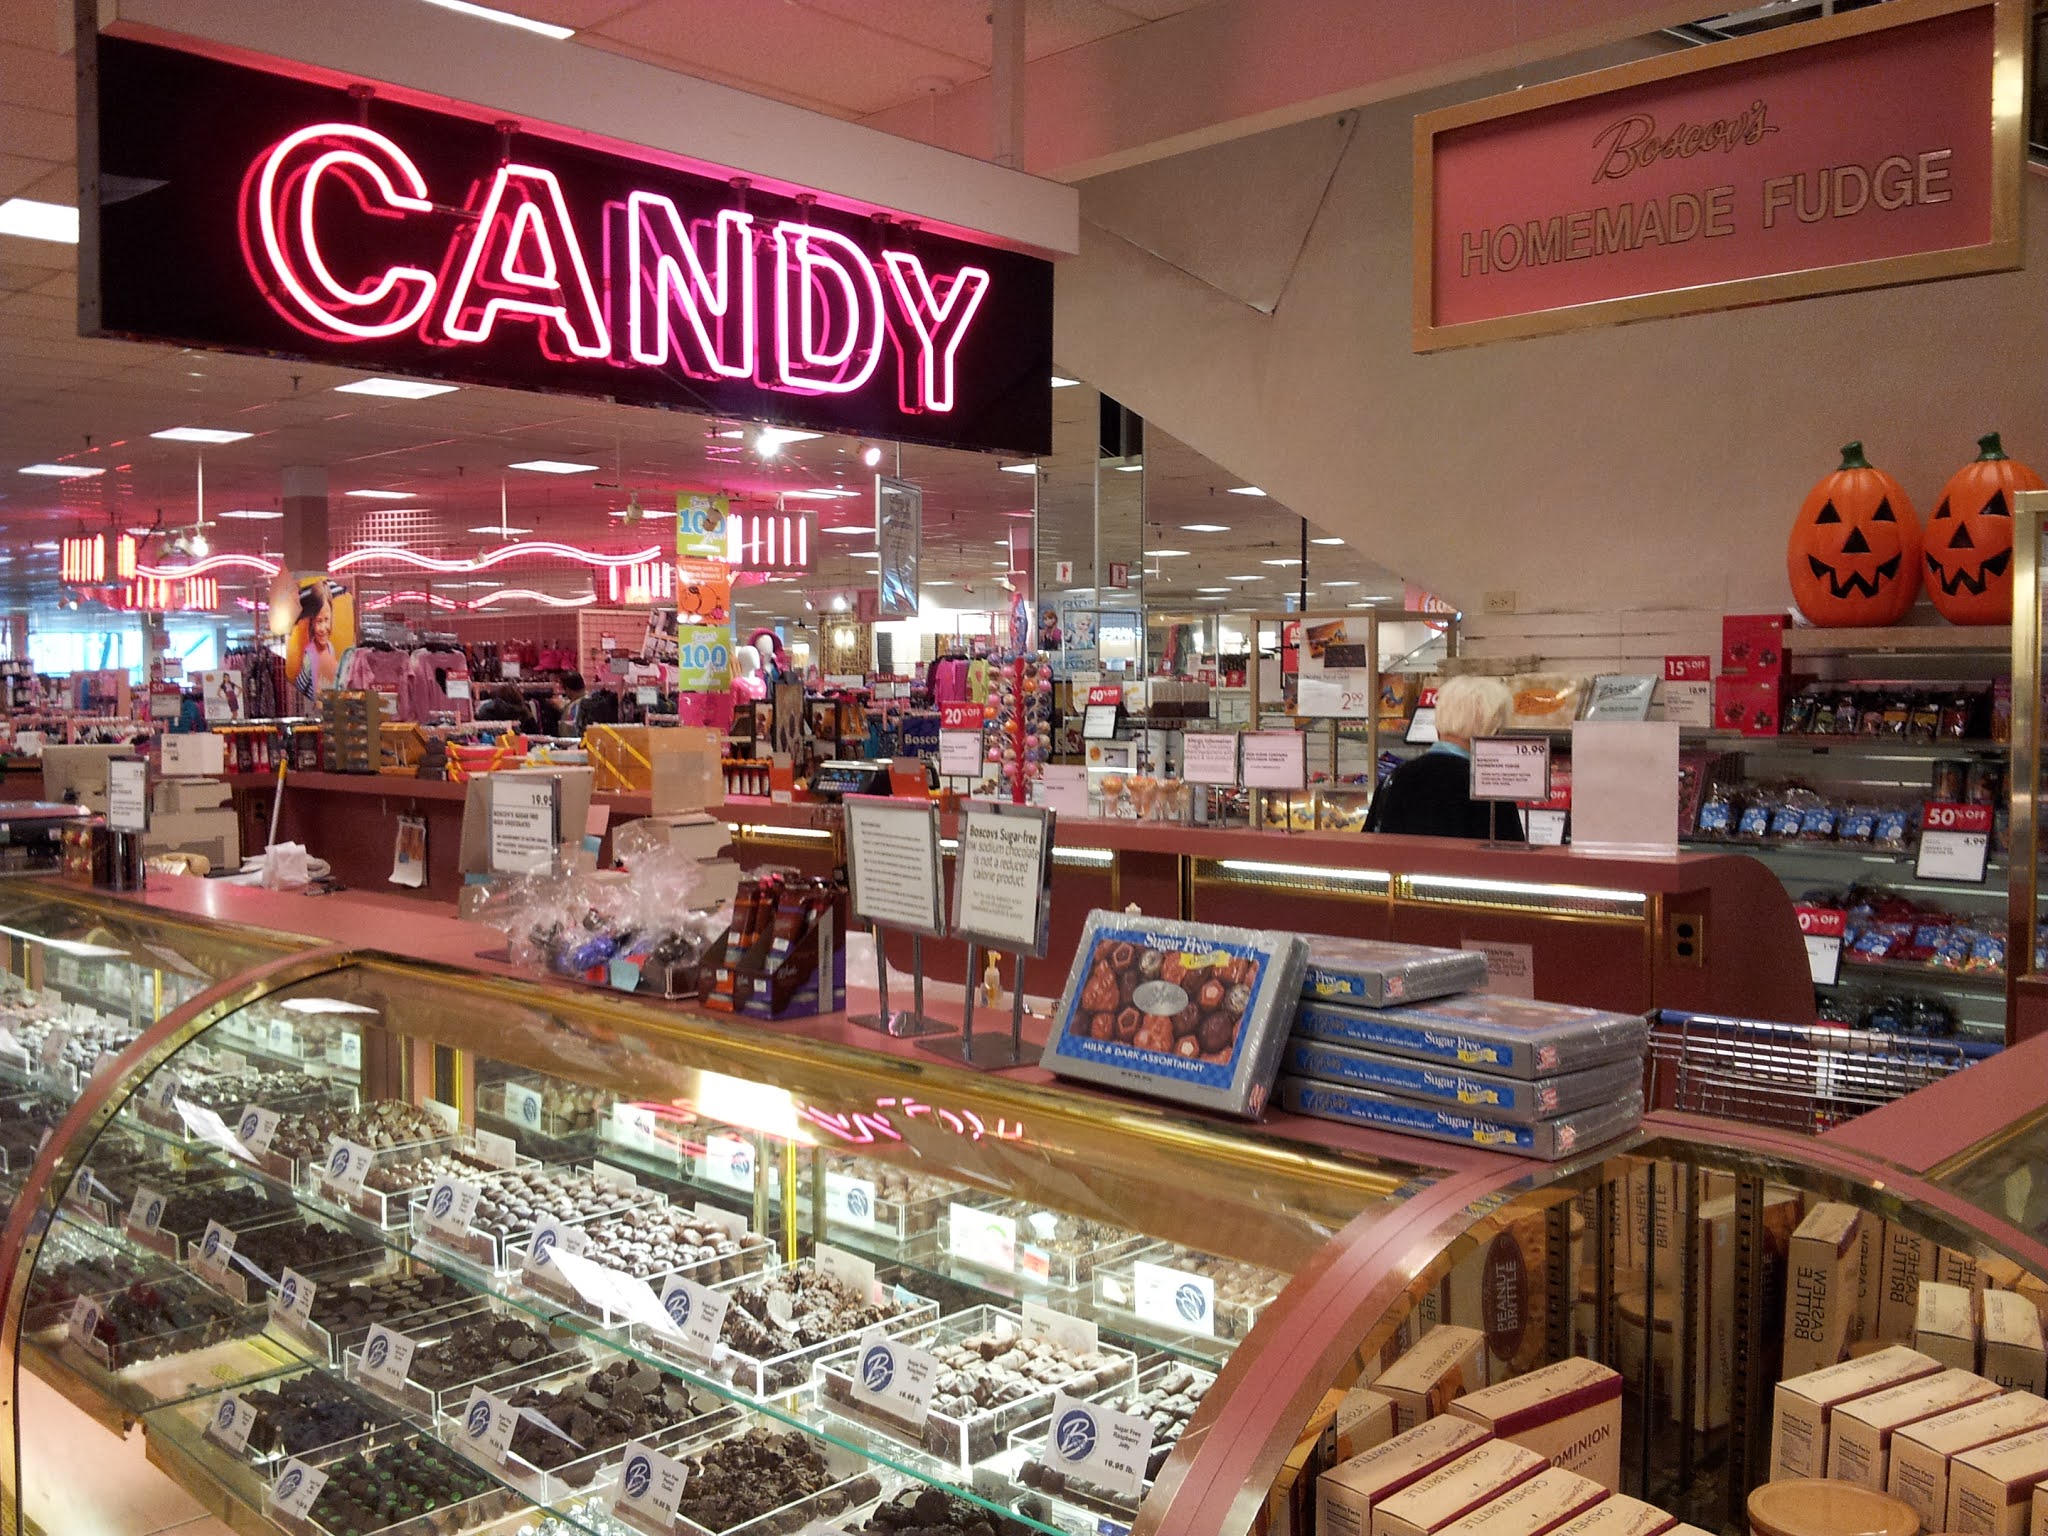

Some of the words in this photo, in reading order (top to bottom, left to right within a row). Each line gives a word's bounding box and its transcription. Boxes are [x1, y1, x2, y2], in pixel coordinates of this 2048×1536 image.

[1591, 100, 1779, 184] Boscov's
[1459, 185, 1737, 277] HOMEMADE
[1762, 148, 1953, 229] FUDGE
[257, 121, 991, 414] CANDY
[682, 643, 728, 669] 100
[1692, 660, 1706, 669] OFF
[968, 708, 980, 717] OFF
[904, 733, 940, 745] Bosco
[1515, 744, 1545, 755] 10.99
[1965, 809, 1987, 820] OFF
[969, 824, 999, 840] Boscovs
[1000, 828, 1038, 847] Sugar-free
[1798, 912, 1819, 931] 0%
[1820, 914, 1840, 925] OFF
[1143, 931, 1184, 954] Sugar
[1184, 935, 1213, 954] Free
[1315, 969, 1337, 985] Free
[1424, 1031, 1456, 1049] Sugar
[1457, 1036, 1482, 1051] Free
[1082, 1041, 1104, 1054] MILK
[1114, 1047, 1140, 1062] DARK
[1140, 1052, 1205, 1073] ASSORTMENT
[1423, 1071, 1456, 1089] Sugar
[1457, 1077, 1482, 1092] Free
[1436, 1111, 1472, 1130] Sugar
[1472, 1118, 1499, 1133] Free
[1635, 1183, 1648, 1247] CASHEW
[1654, 1183, 1669, 1249] BRITTLE
[1495, 1262, 1508, 1333] PEANUT
[1506, 1260, 1519, 1331] BRITTLE
[1112, 1431, 1139, 1447] Raspberry
[1114, 1423, 1130, 1435] Sugar
[1129, 1429, 1142, 1438] Free
[1391, 1424, 1437, 1450] CASHEW
[1348, 1441, 1393, 1470] BRITTLE
[1552, 1423, 1610, 1469] OMINION
[1445, 1449, 1490, 1477] CASHEW
[1402, 1470, 1446, 1500] BRITTLE
[1504, 1479, 1549, 1507] CASHEW
[1458, 1500, 1505, 1531] BRITTLE
[1569, 1505, 1614, 1535] CASHEW
